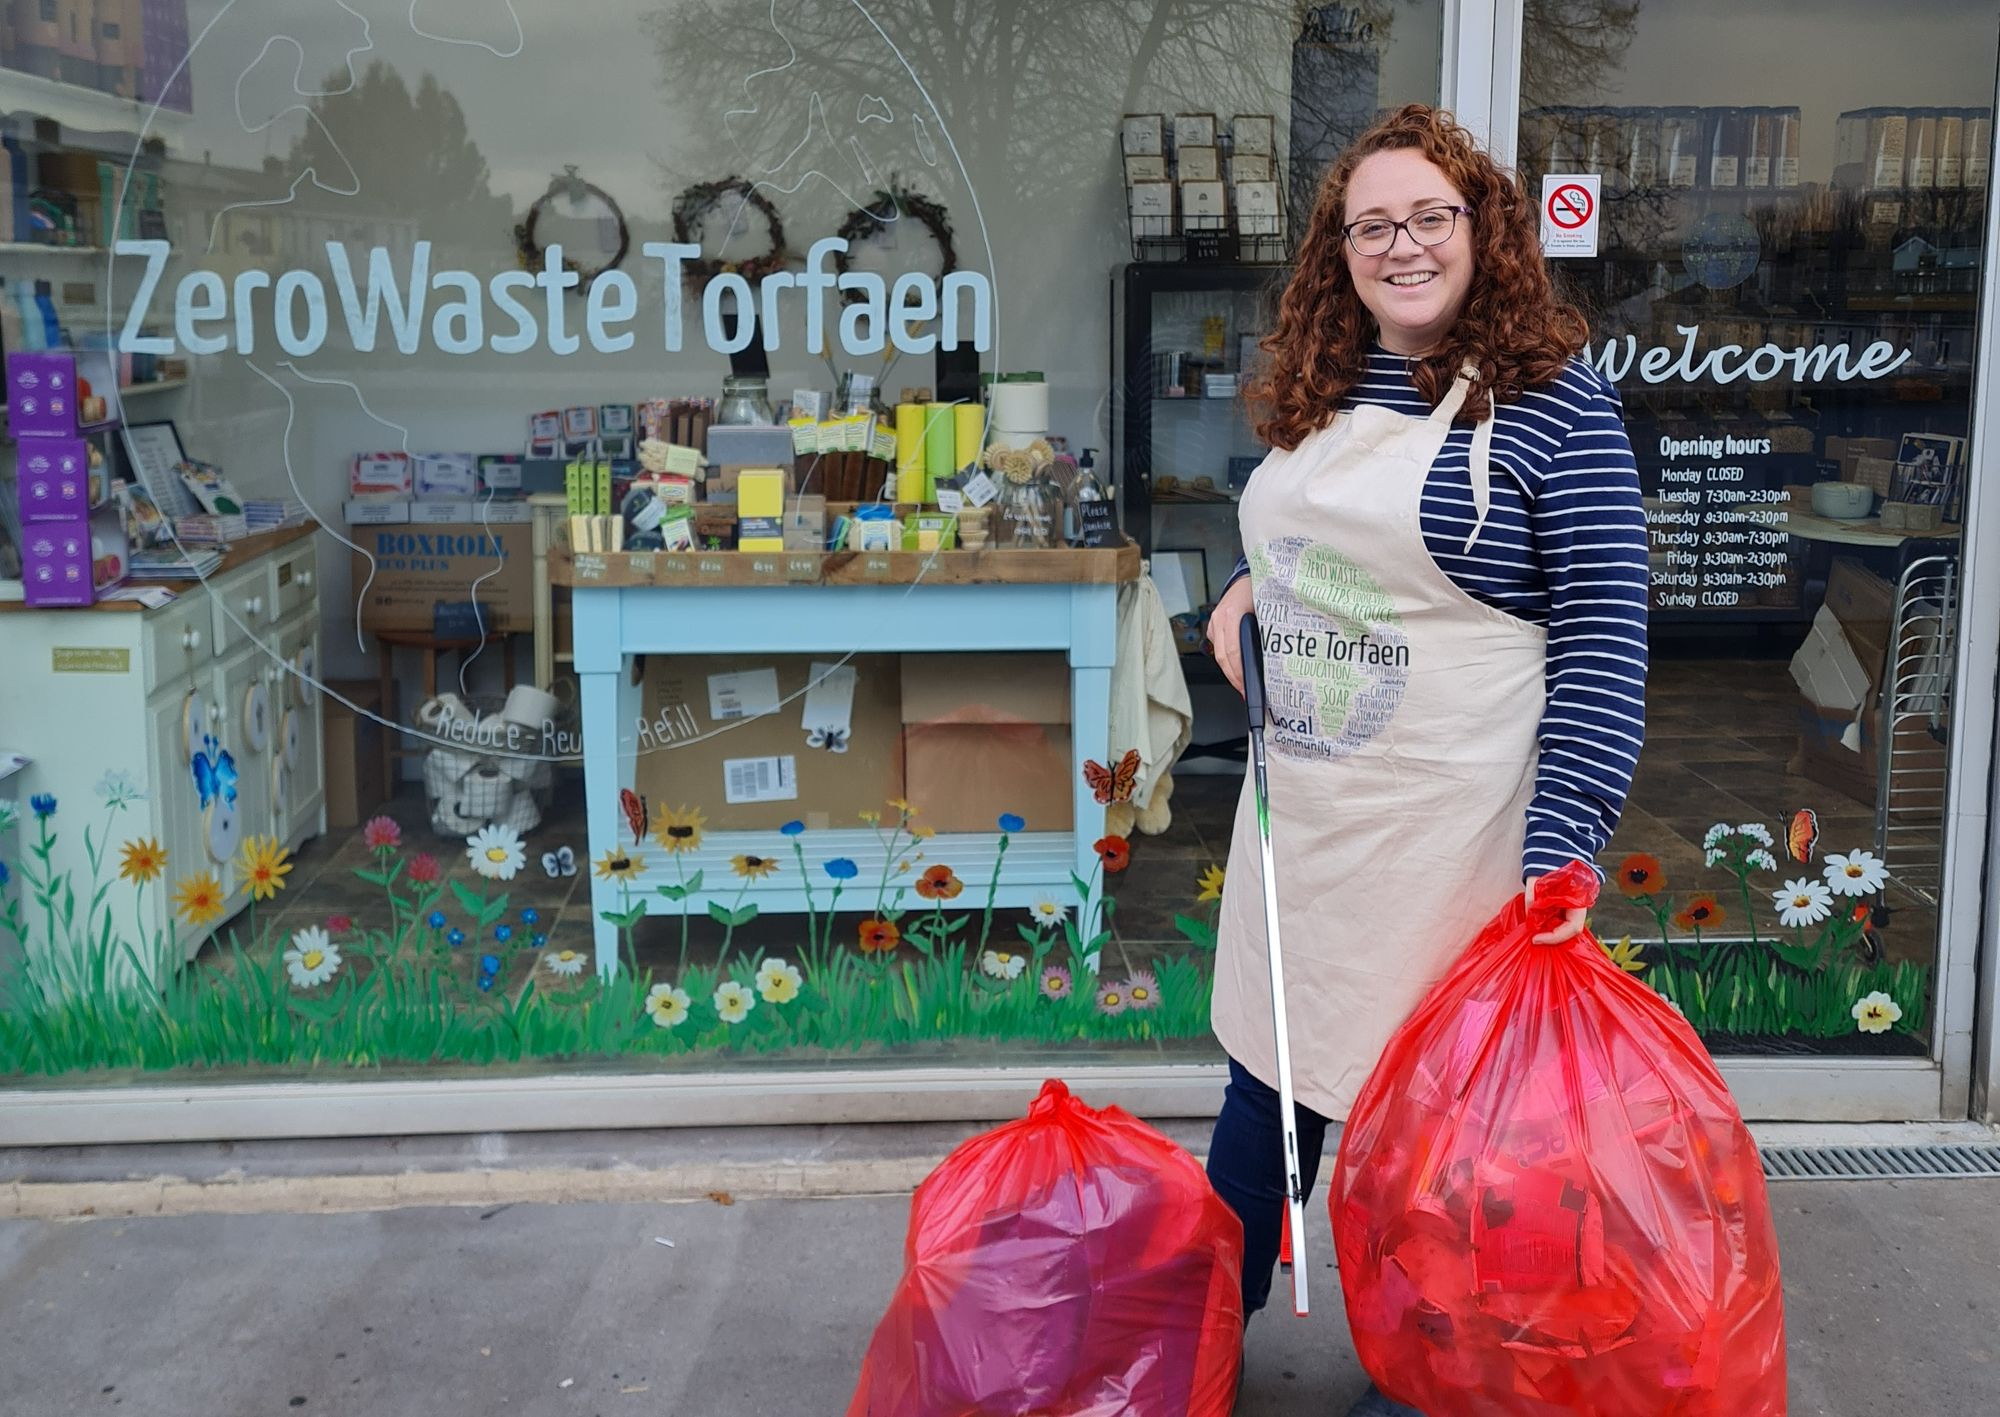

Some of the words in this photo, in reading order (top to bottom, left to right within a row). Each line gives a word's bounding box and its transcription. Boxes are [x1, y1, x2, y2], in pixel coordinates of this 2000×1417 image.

[114, 239, 328, 357] Zero
[325, 240, 638, 356] Waste
[642, 237, 991, 356] Torfaen
[1583, 324, 1912, 385] Welcome
[1660, 434, 1724, 461] Opening
[1725, 434, 1771, 455] hours
[1661, 467, 1702, 484] Monday
[1706, 467, 1744, 481] CLOSED
[1656, 488, 1701, 505] Tuesday
[1706, 489, 1791, 505] 7:30am-2:30pm
[1081, 504, 1109, 517] Please
[1703, 510, 1789, 526] 9:30am-2:30pm
[376, 533, 509, 559] BOXROLL
[1649, 529, 1700, 547] Thursday
[1702, 530, 1789, 548] 9:30am-7:30pm
[1666, 550, 1699, 568] Friday
[1702, 551, 1787, 568] 9:30am-2:30pm
[1305, 559, 1327, 580] ZERO
[1329, 566, 1358, 586] WASTE
[1650, 571, 1698, 587] Saturday
[1702, 572, 1787, 589] 9:30am-2:30pm
[1327, 584, 1351, 605] TIPS
[1656, 591, 1697, 608] Sunday
[1702, 591, 1739, 606] CLOSED
[1256, 600, 1289, 623] REPAIR
[1352, 603, 1393, 622] REDUCE
[1325, 631, 1409, 667] Torfaen
[1300, 659, 1351, 681] EDUCATION
[1283, 685, 1304, 708] HELP
[1323, 685, 1349, 707] SOAP
[1371, 685, 1400, 700] CHARITY
[1356, 709, 1384, 723] STORAGE
[1360, 699, 1394, 713] BATHROOM
[436, 704, 521, 751] Reduce
[542, 718, 582, 756] Reu
[635, 703, 699, 749] Refill
[1268, 707, 1313, 735] Local
[1275, 731, 1331, 757] Community
[1347, 730, 1372, 739] Respect
